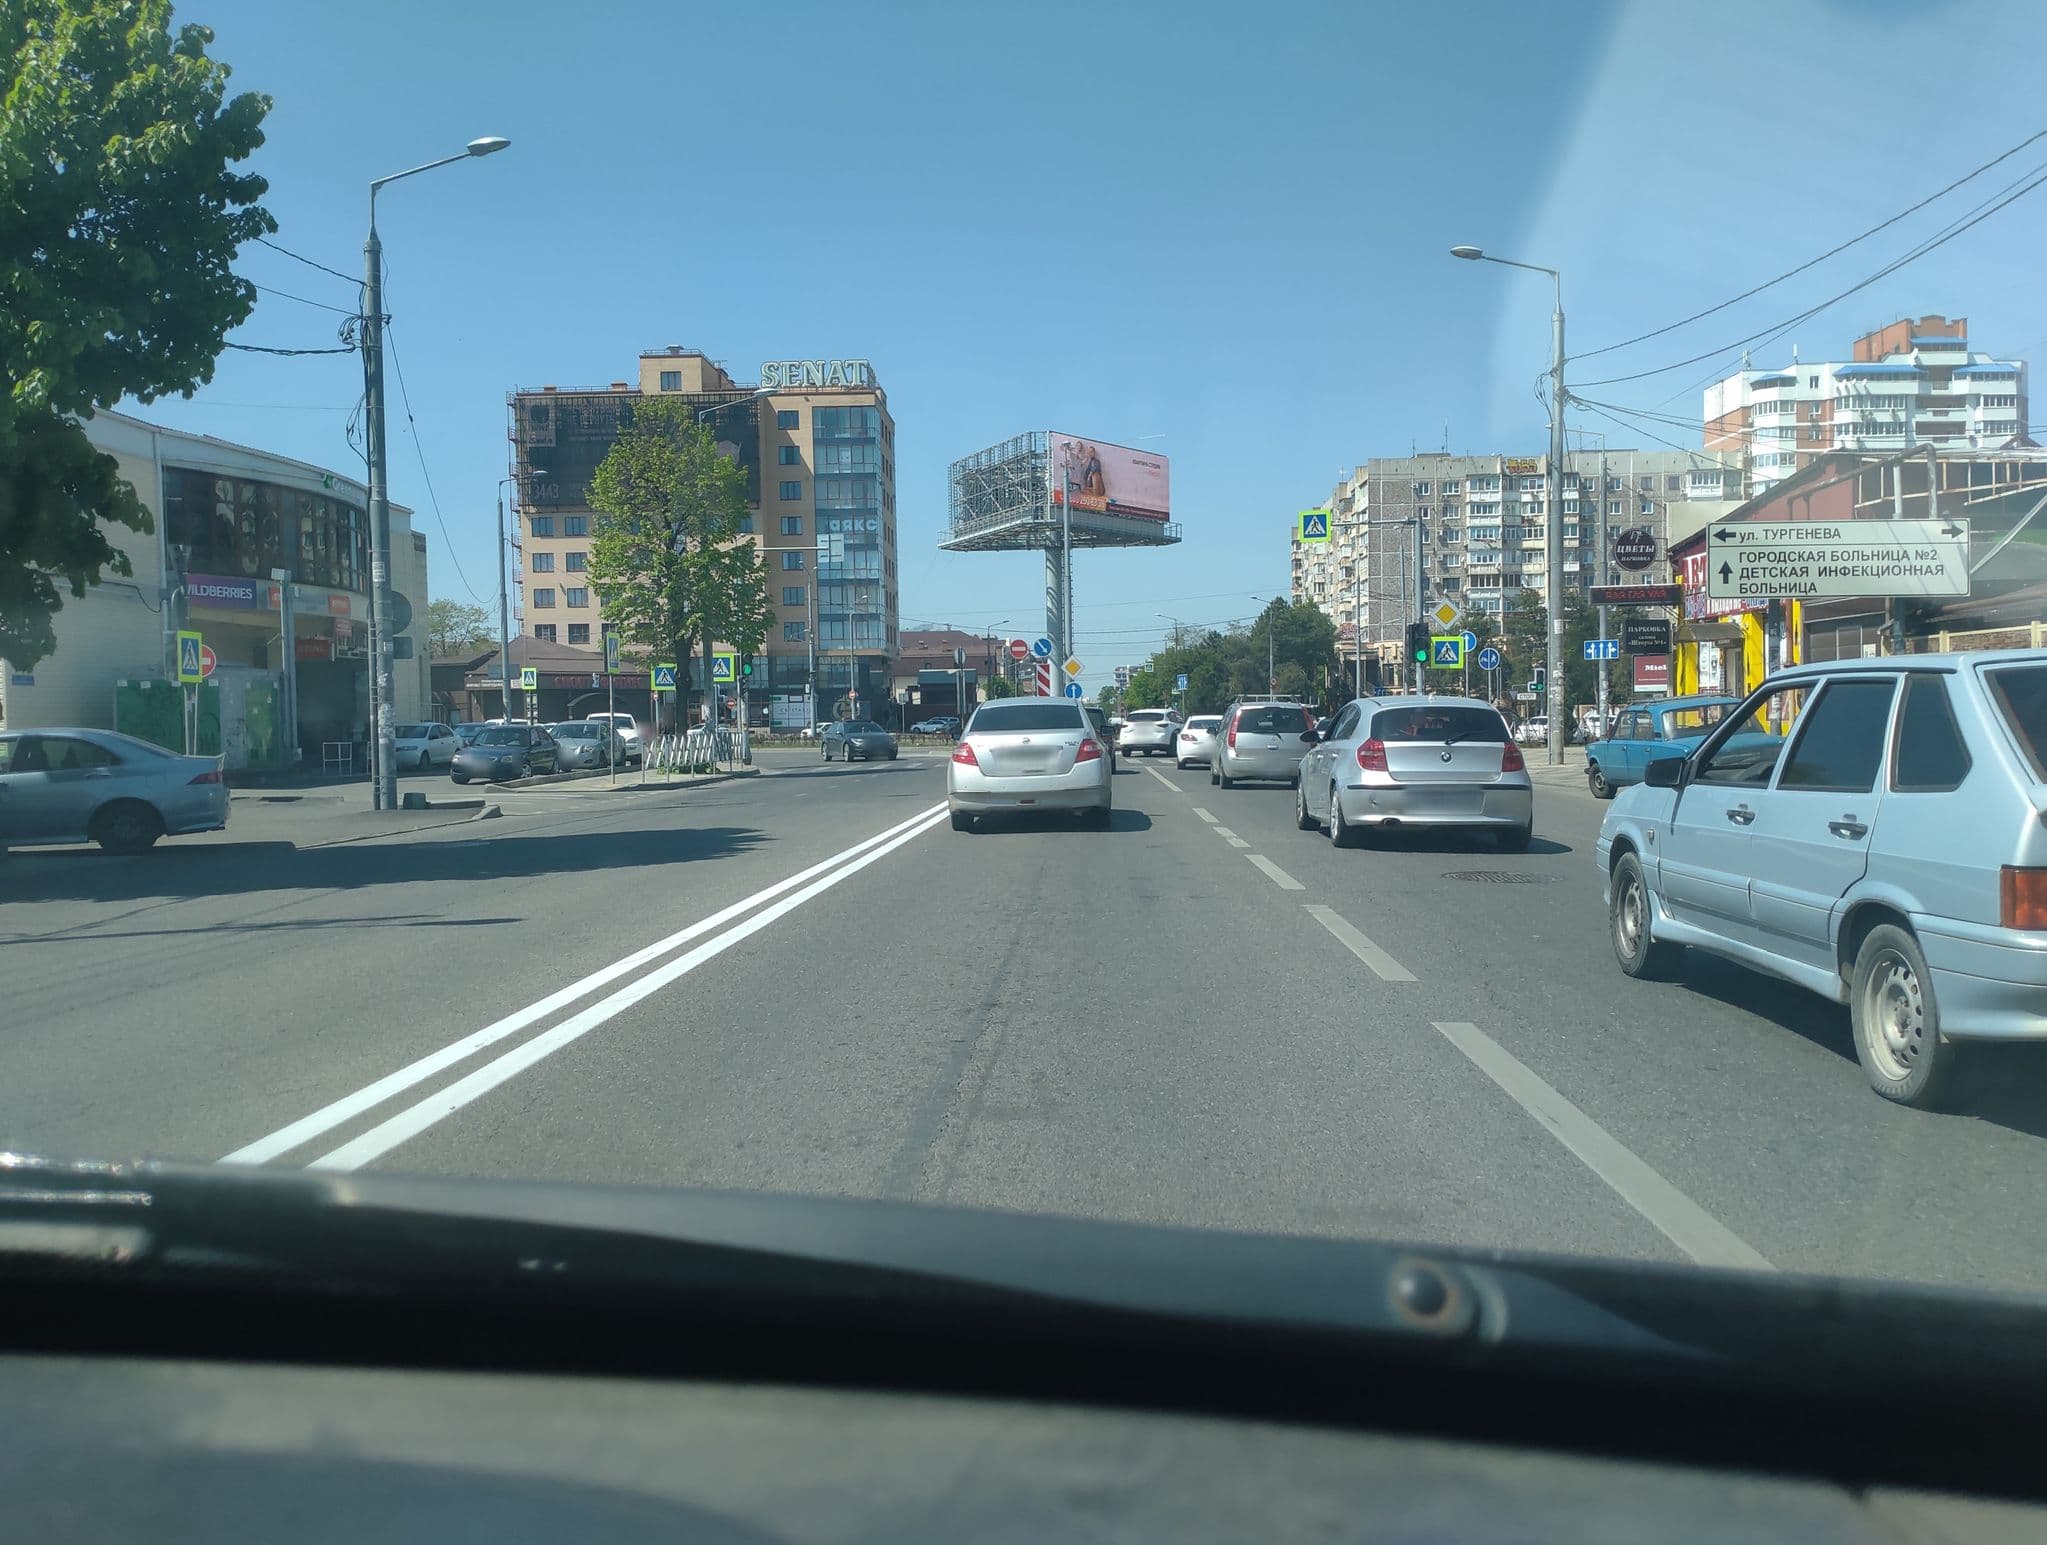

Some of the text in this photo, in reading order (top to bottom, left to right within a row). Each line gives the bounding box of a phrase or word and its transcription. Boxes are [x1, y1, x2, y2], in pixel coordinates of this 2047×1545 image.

[760, 360, 869, 388] SENAT
[1738, 528, 1841, 544] ул. ТУРГЕНЕВА
[1616, 545, 1655, 554] ЦВЕТЫ
[1738, 549, 1937, 563] ГОРОДСКАЯ БОЛЬНИЦА №2
[1739, 564, 1944, 580] ДЕТСКАЯ ИНФЕКЦИОННАЯ
[1739, 582, 1818, 595] БОЛЬНИЦА
